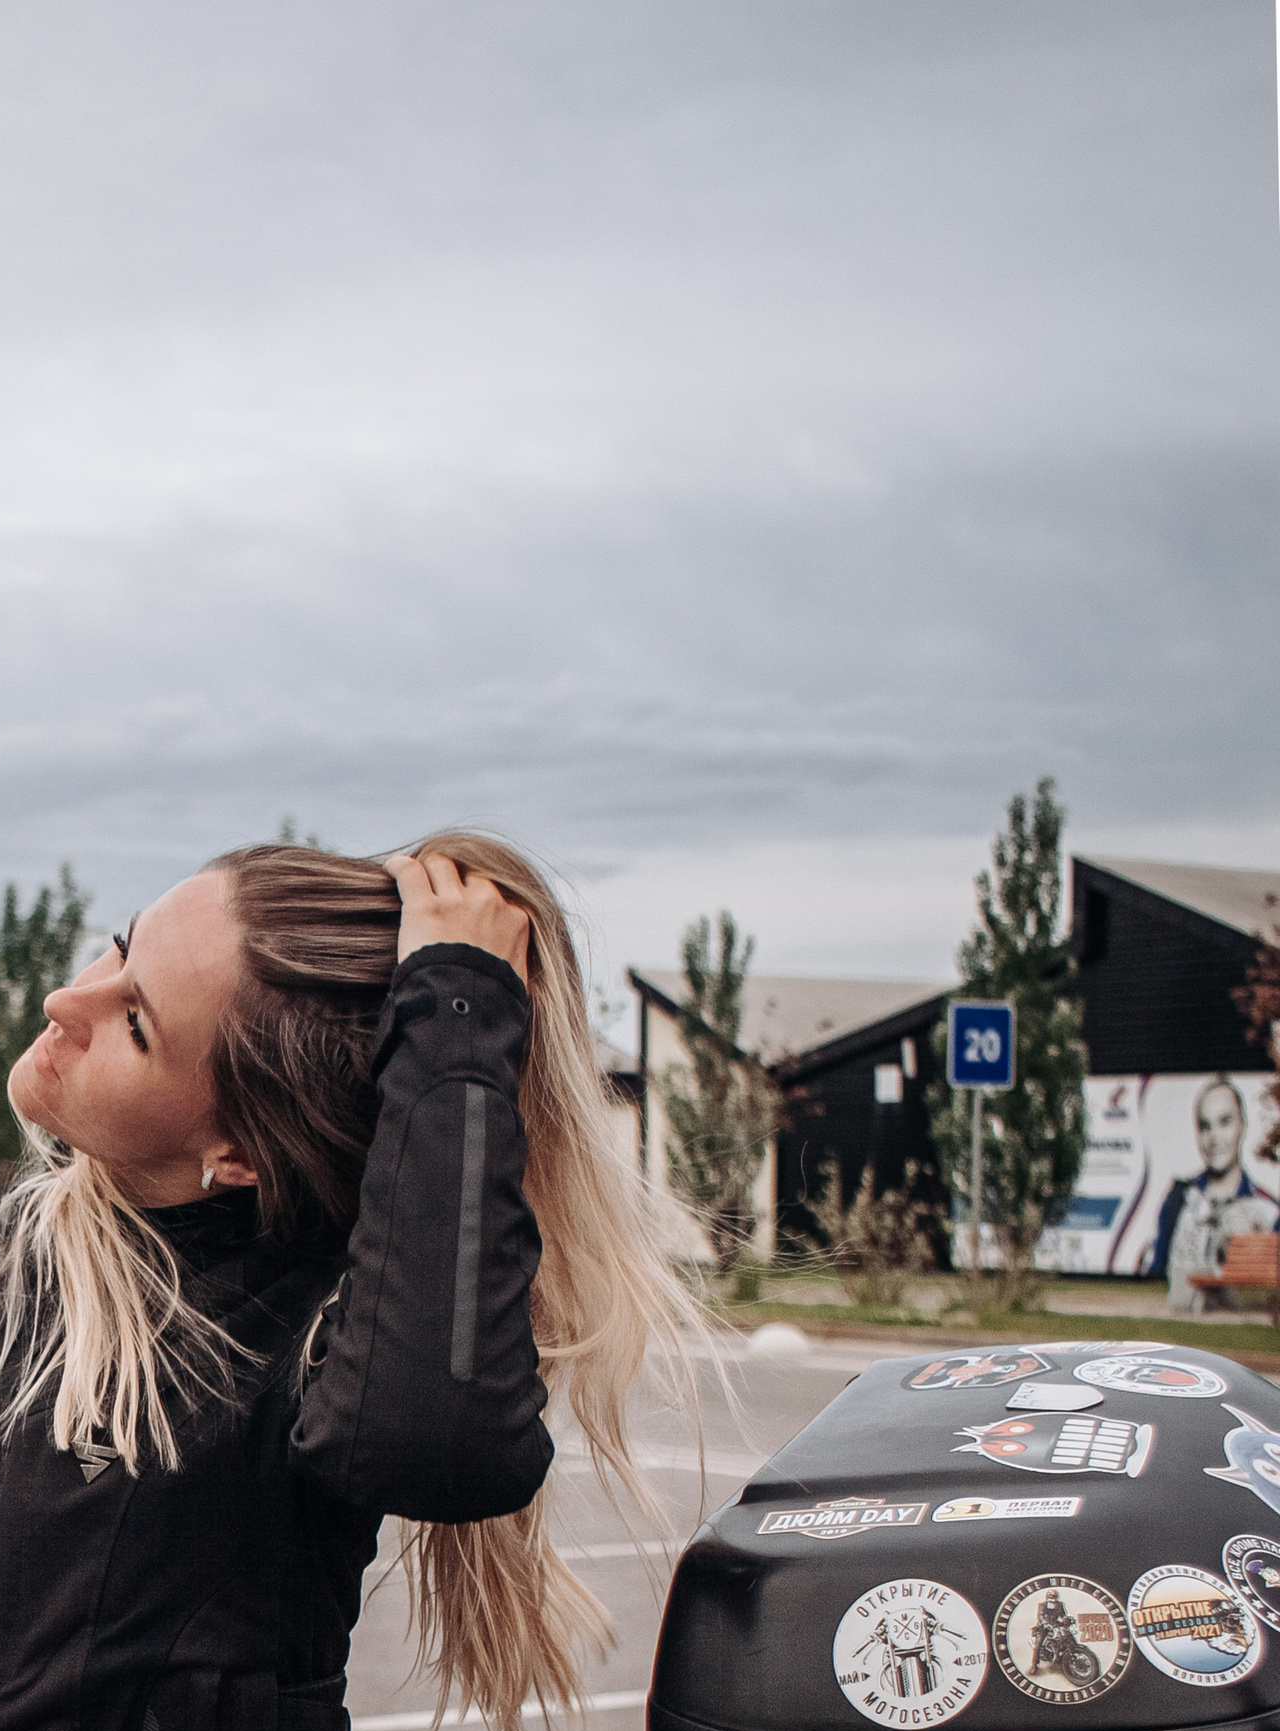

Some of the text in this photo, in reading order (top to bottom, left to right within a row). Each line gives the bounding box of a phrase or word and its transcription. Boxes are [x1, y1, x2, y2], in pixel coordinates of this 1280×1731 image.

[964, 1029, 1000, 1062] 20
[1008, 1500, 1072, 1508] ПЕРВАЯ
[769, 1507, 914, 1530] ДЮЙМ DAY
[1229, 1538, 1261, 1559] КРОМЕ
[1261, 1540, 1280, 1554] НА
[1130, 1567, 1205, 1608] МОТОДВИЖЕНИЕ
[856, 1583, 950, 1618] ОТКРЫТИЕ
[996, 1578, 1127, 1636] ЗАКРЫТИЕ МОТО СЕЗОНА
[1132, 1601, 1212, 1627] ОТКРЫТИЕ
[1079, 1624, 1113, 1642] 2020
[1137, 1617, 1217, 1635] МОТО СЕЗОНА
[1191, 1624, 1222, 1638] 2021
[964, 1653, 987, 1667] 2017
[1172, 1659, 1252, 1683] ВОРОНЕЖ 2021
[839, 1671, 859, 1686] МАЙ
[1001, 1657, 1096, 1701] МОТОДВИЖЕНИЕ
[1115, 1650, 1129, 1667] МС
[863, 1677, 971, 1724] МОТОСЕЗОНА
